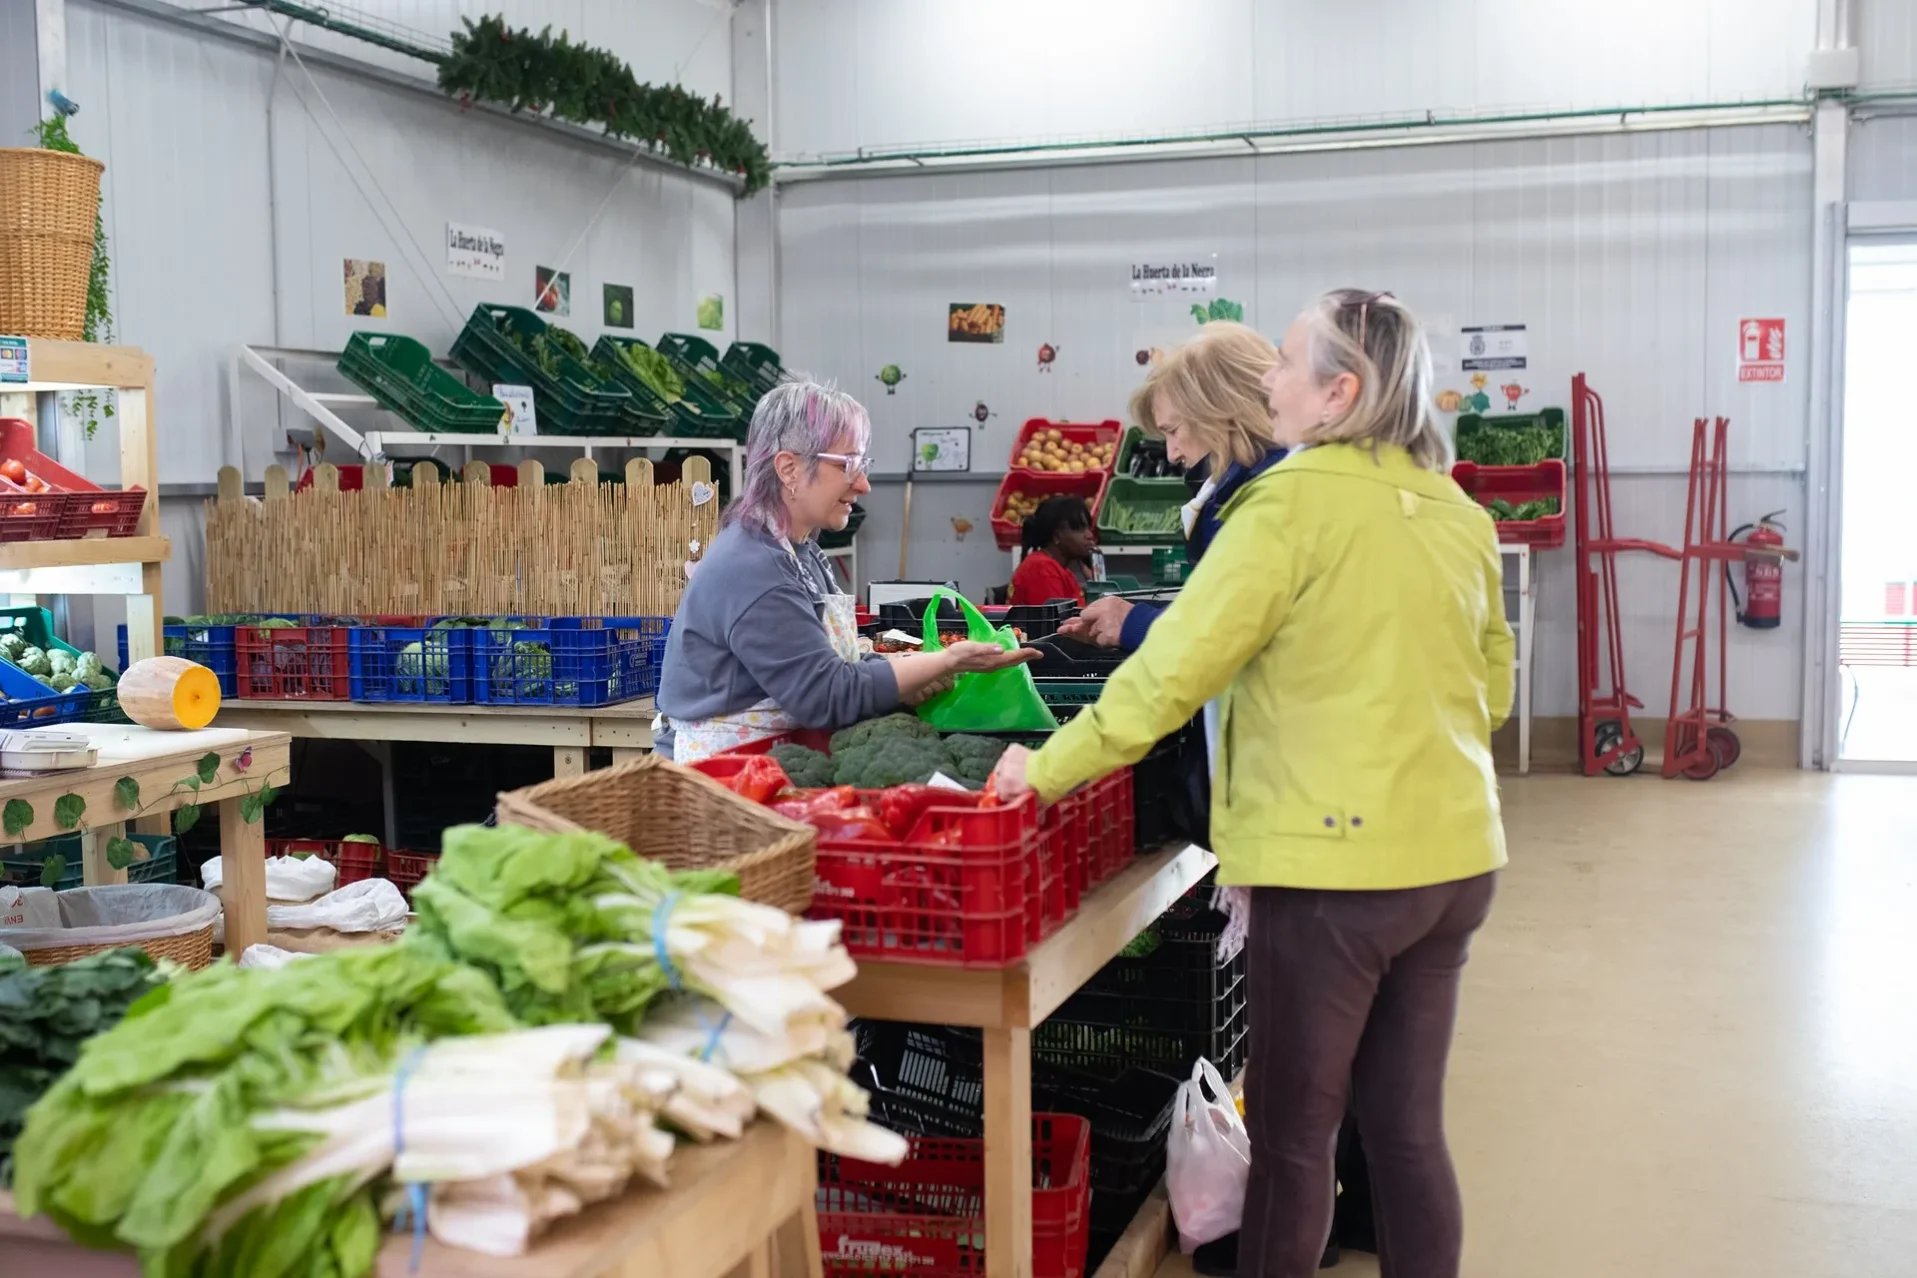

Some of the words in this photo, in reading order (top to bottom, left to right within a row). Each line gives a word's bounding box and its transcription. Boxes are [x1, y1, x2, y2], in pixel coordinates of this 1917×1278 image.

[450, 229, 457, 248] La
[1132, 264, 1141, 280] La
[1143, 264, 1170, 279] Huerta
[1172, 264, 1181, 279] de
[1182, 264, 1190, 279] la
[1741, 366, 1782, 379] EXTINTOR
